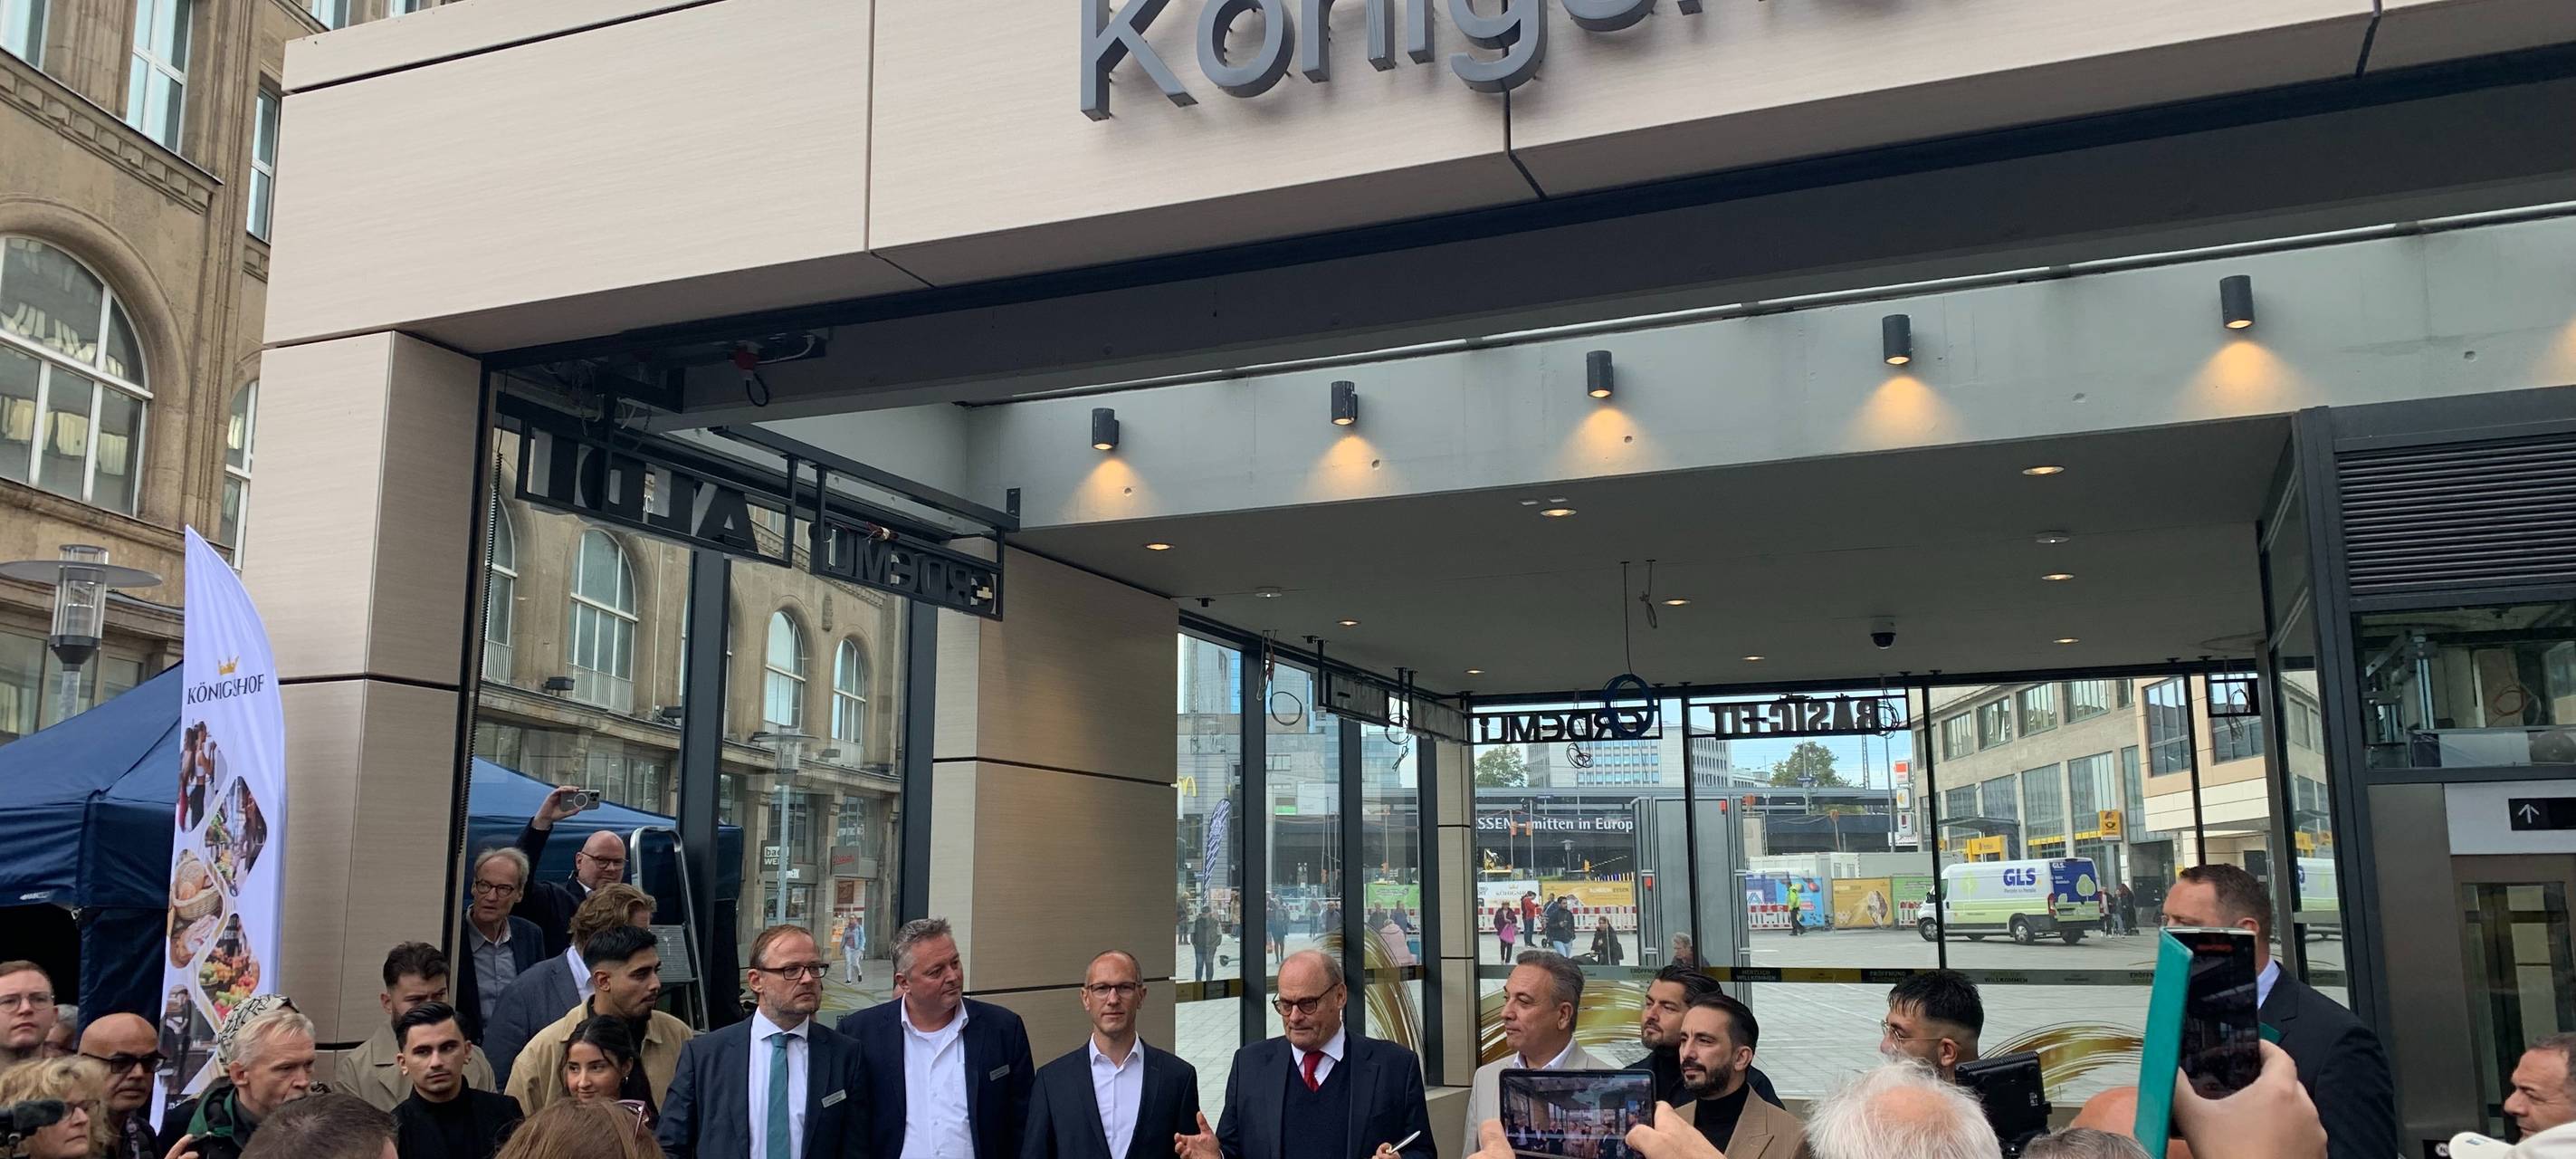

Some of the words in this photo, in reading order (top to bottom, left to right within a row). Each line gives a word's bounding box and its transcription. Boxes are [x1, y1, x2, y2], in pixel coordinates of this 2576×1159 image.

[186, 674, 265, 704] KÖNIGSHOF
[1477, 817, 1512, 830] SSEN
[1531, 817, 1574, 830] mitten
[1579, 817, 1591, 830] in
[1596, 817, 1634, 833] Europ
